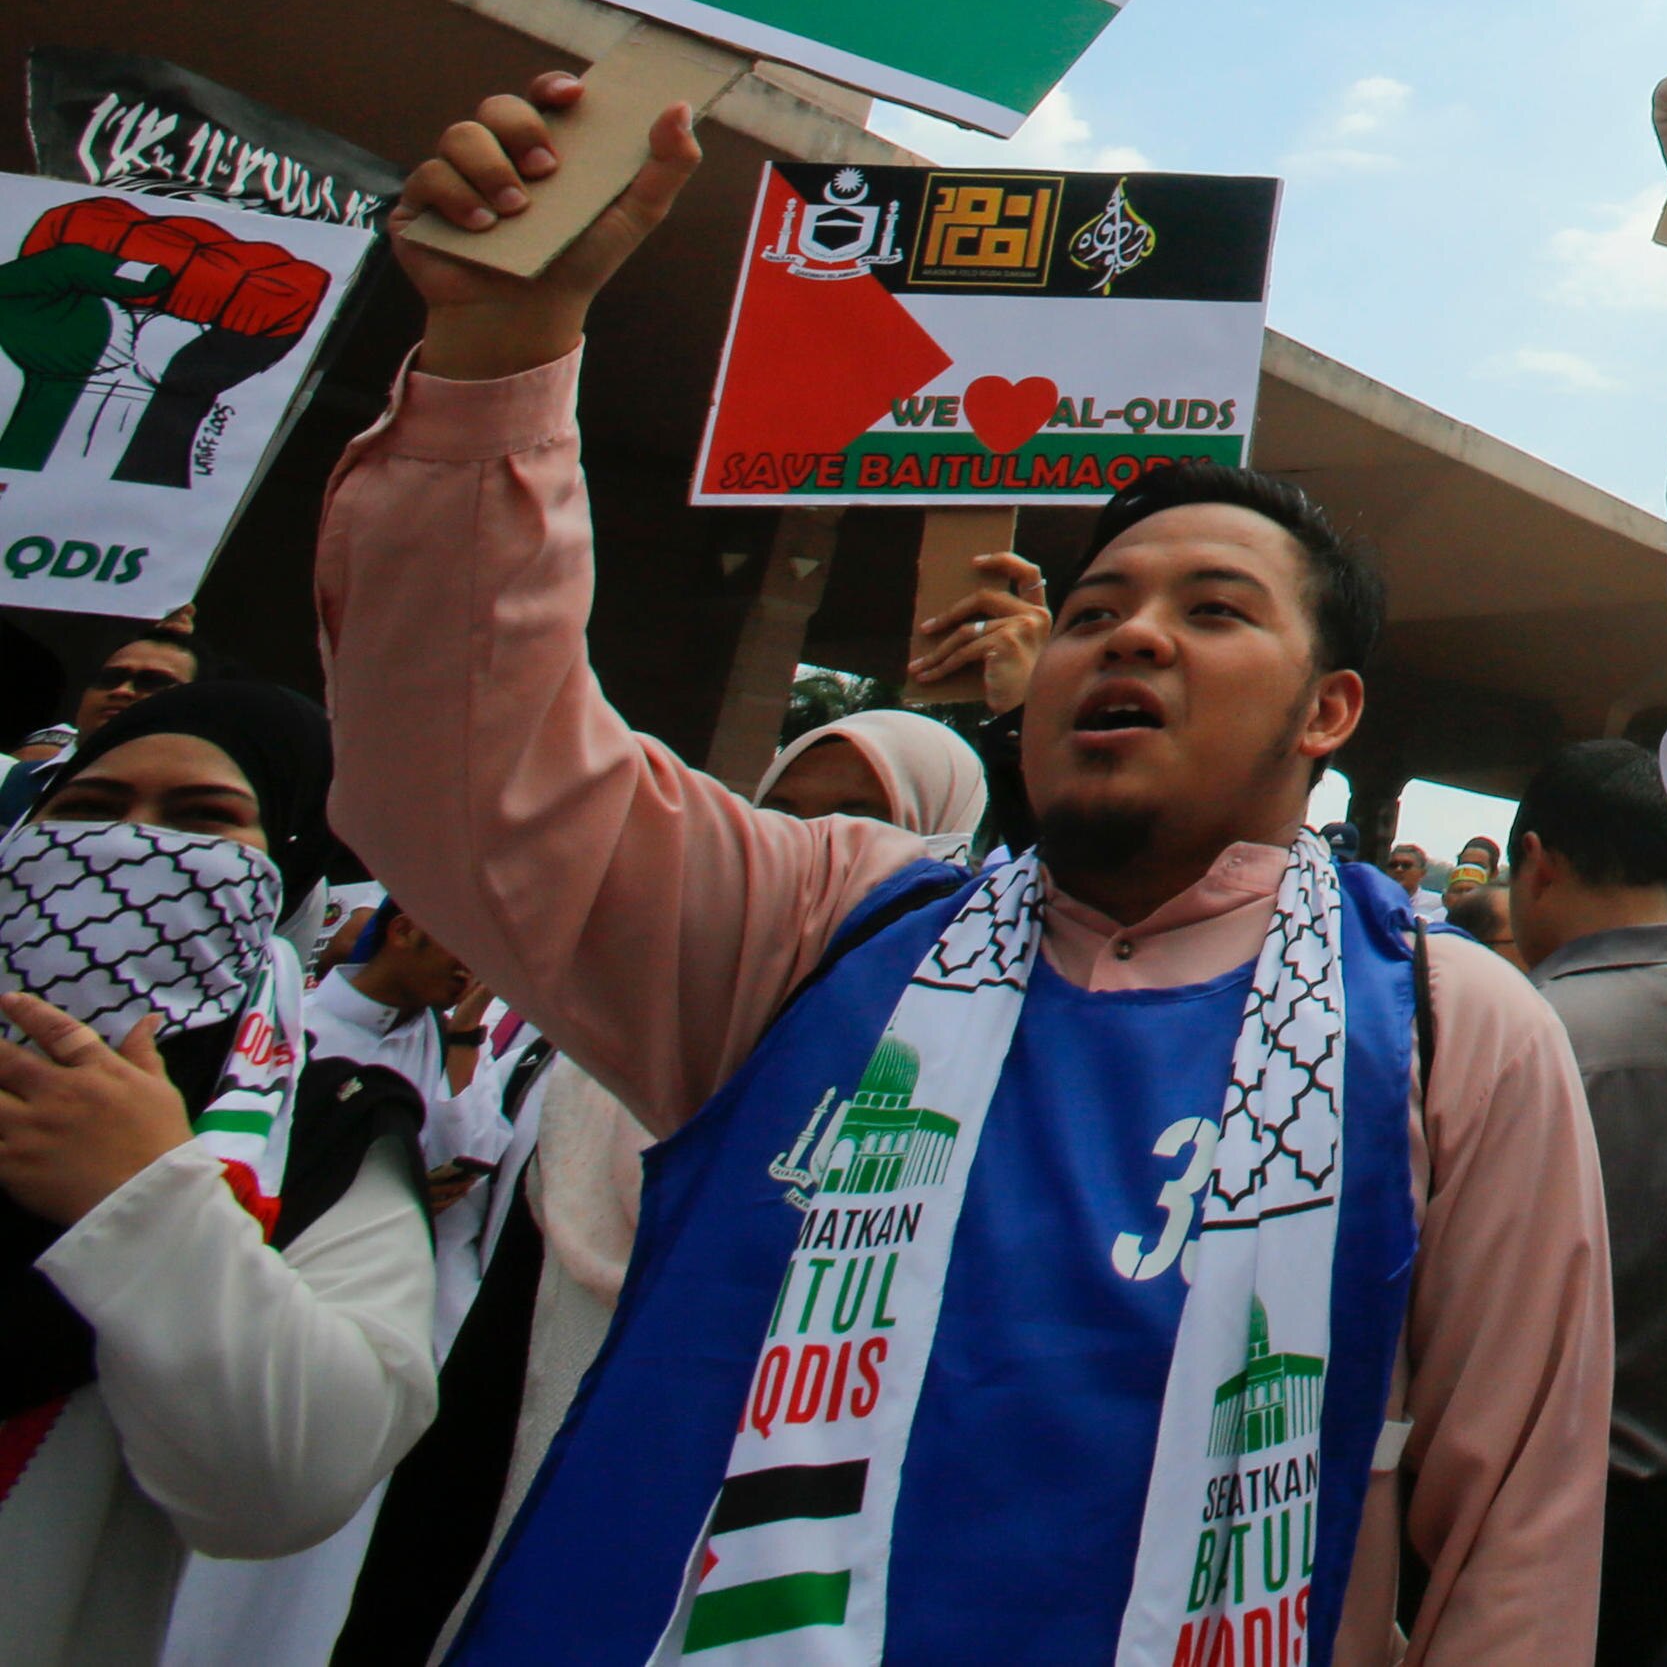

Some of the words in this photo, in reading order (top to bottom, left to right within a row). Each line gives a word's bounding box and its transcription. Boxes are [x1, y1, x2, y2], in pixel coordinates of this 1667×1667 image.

[891, 395, 960, 427] WE
[1046, 396, 1236, 434] AL-QUDS
[720, 452, 847, 489] SAVE
[858, 453, 1213, 491] BAITULMAQ
[1111, 1116, 1220, 1285] 3
[738, 1336, 889, 1440] QDIS
